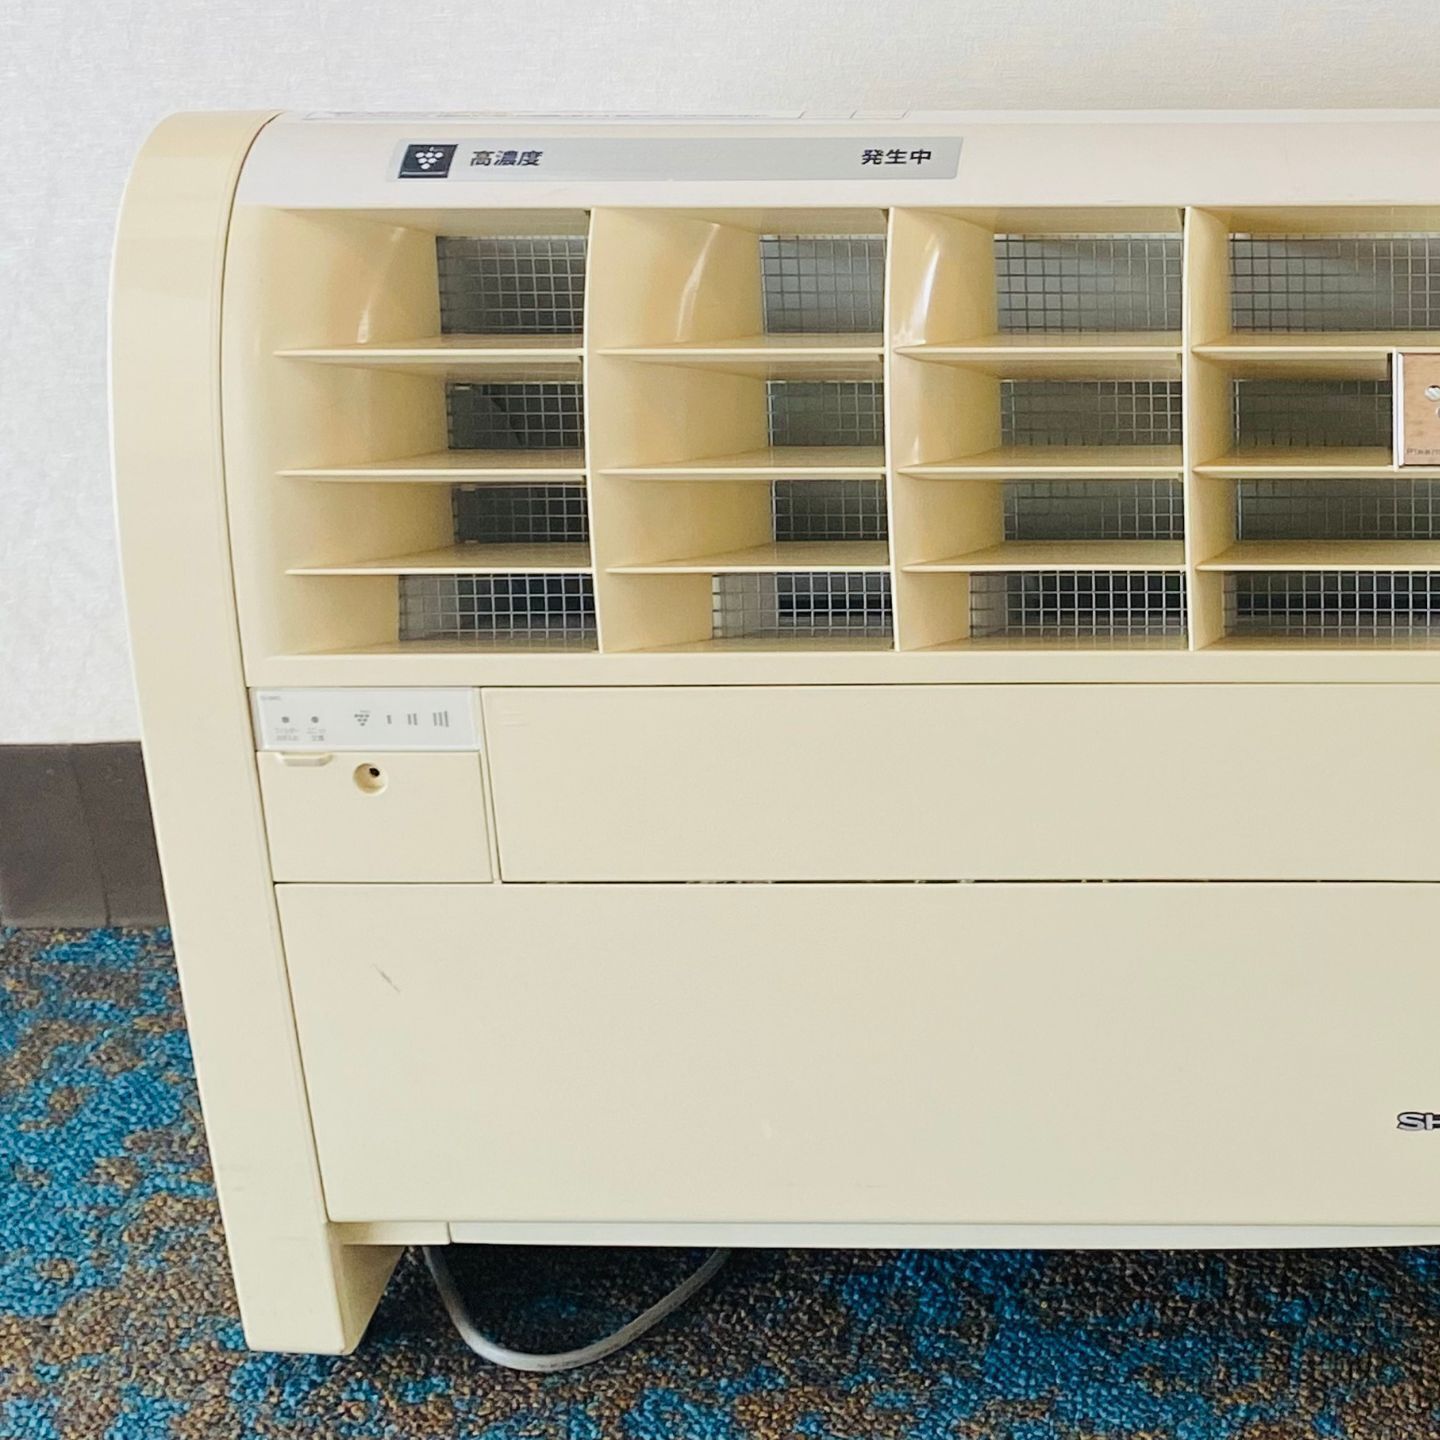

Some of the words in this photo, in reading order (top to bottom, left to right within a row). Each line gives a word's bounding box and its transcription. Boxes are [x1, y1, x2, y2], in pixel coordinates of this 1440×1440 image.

[470, 150, 543, 166] 高濃度
[861, 149, 932, 165] 発生中
